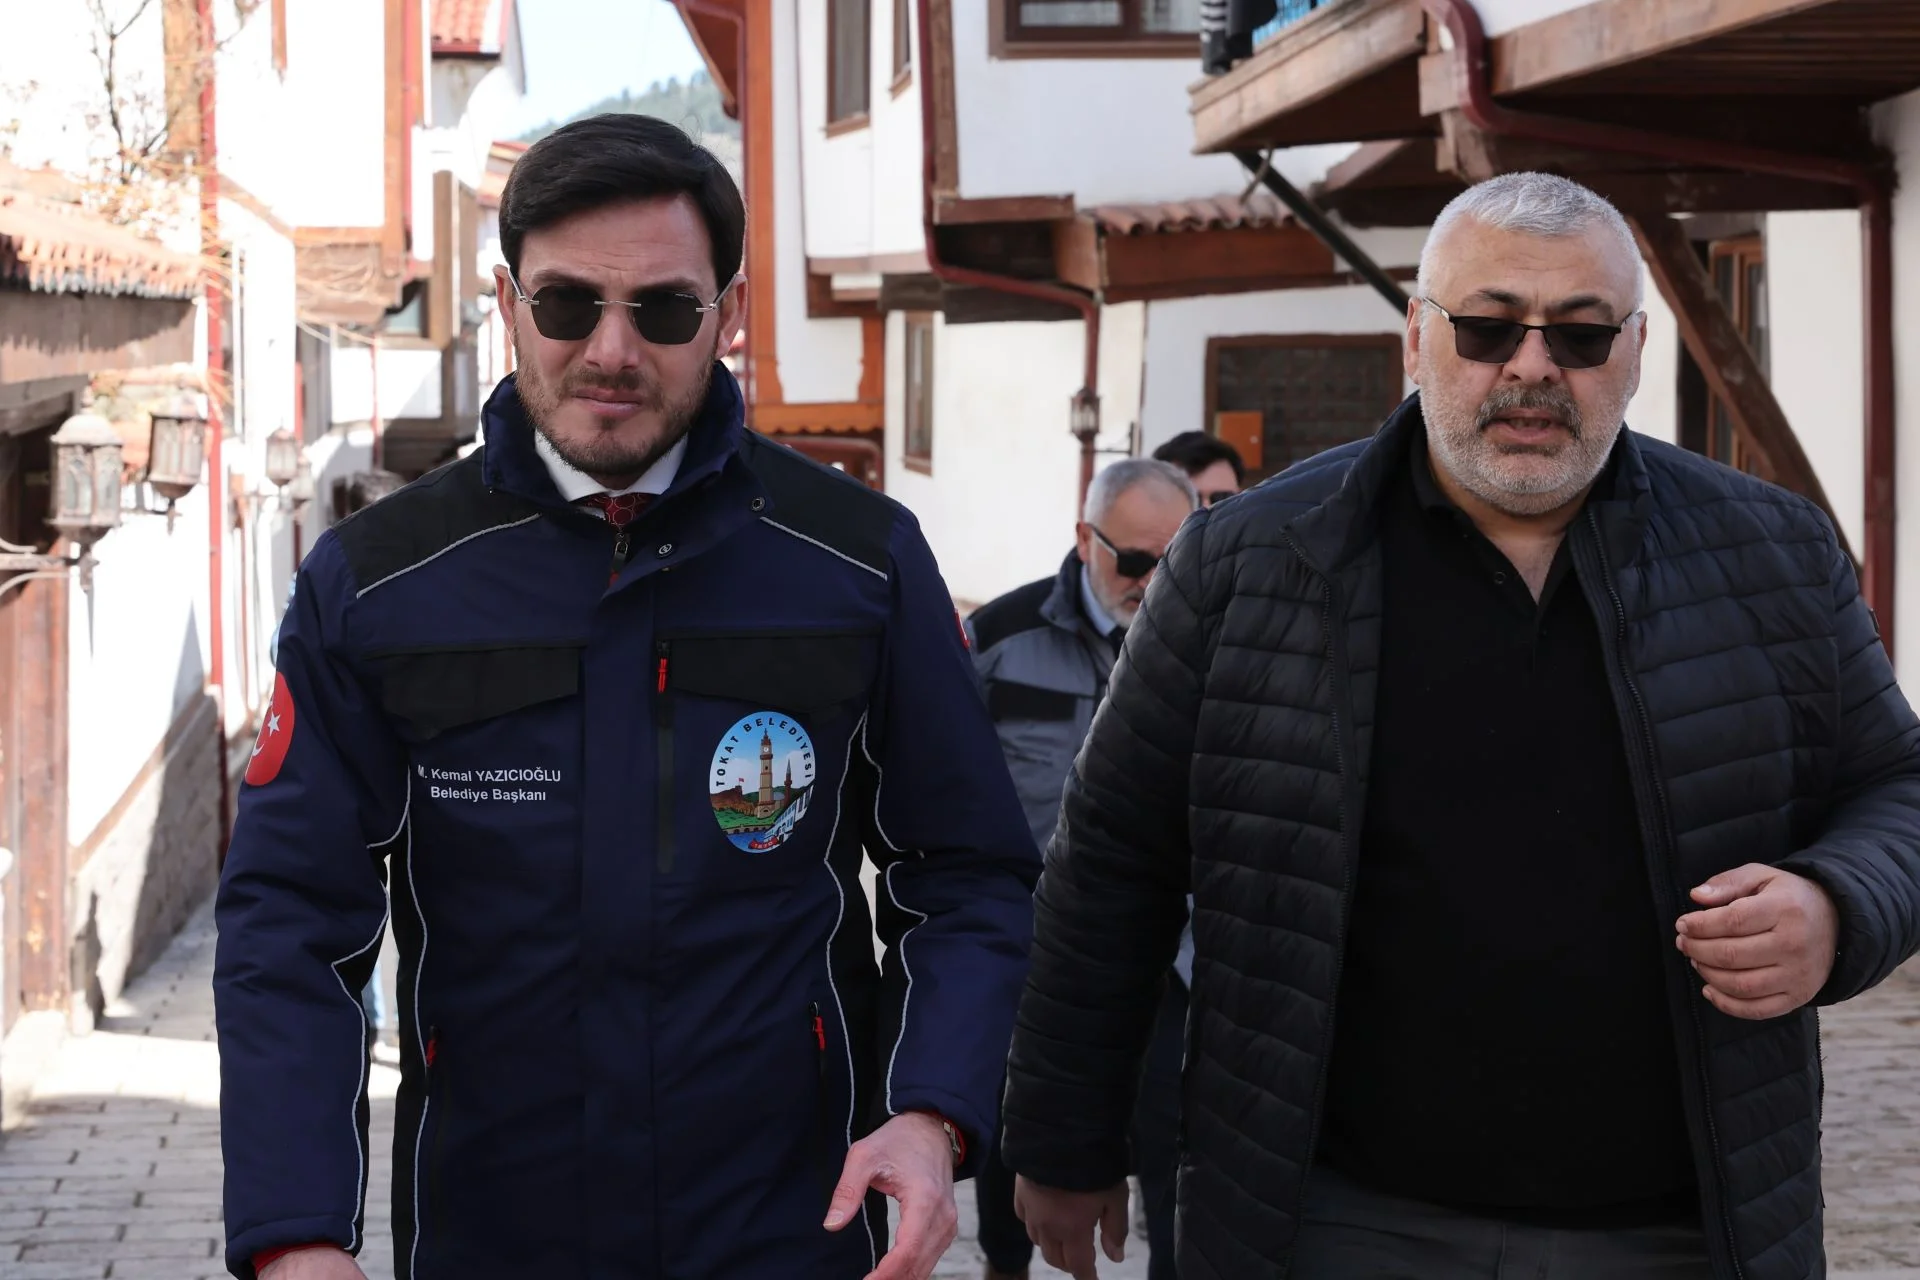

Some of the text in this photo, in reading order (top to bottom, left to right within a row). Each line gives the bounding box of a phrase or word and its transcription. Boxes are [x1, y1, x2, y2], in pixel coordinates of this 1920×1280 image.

[716, 717, 814, 787] TOKAT BELEDİYESİ
[431, 768, 472, 782] Kemal
[475, 766, 561, 782] YAZICIOĞLU
[430, 786, 546, 804] Belediye Başkanı
